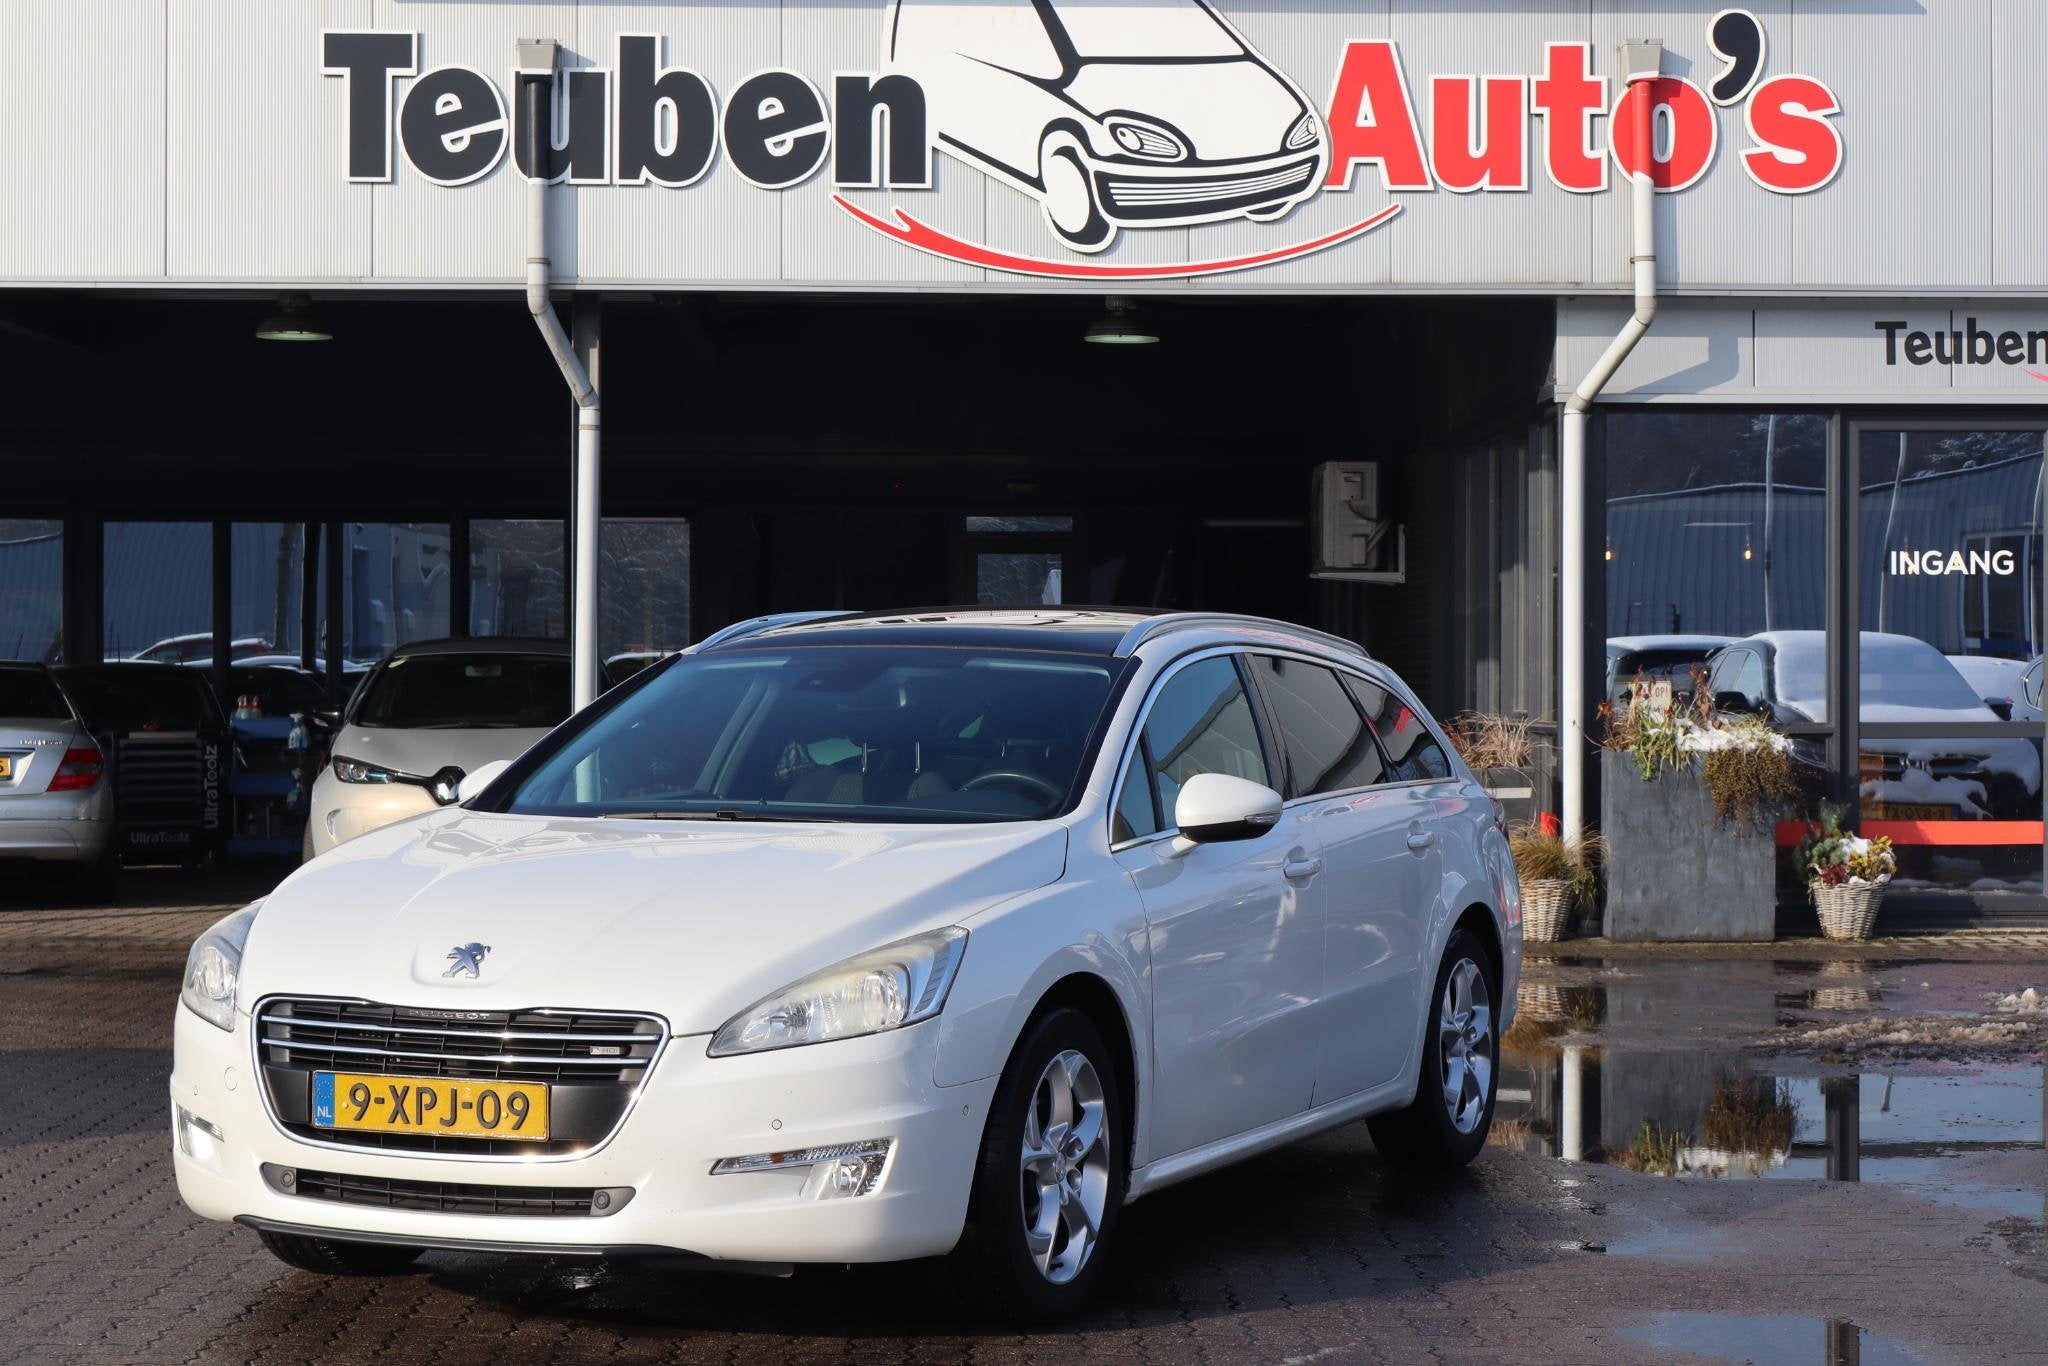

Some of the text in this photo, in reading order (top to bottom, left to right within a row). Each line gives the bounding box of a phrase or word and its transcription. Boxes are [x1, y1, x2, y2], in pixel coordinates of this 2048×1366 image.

[322, 9, 1843, 193] Teuben Auto's
[1890, 550, 2015, 576] INGANG
[409, 1008, 490, 1020] PEUGEOT
[317, 1105, 332, 1118] NL
[349, 1082, 530, 1130] 9-XPJ-09
